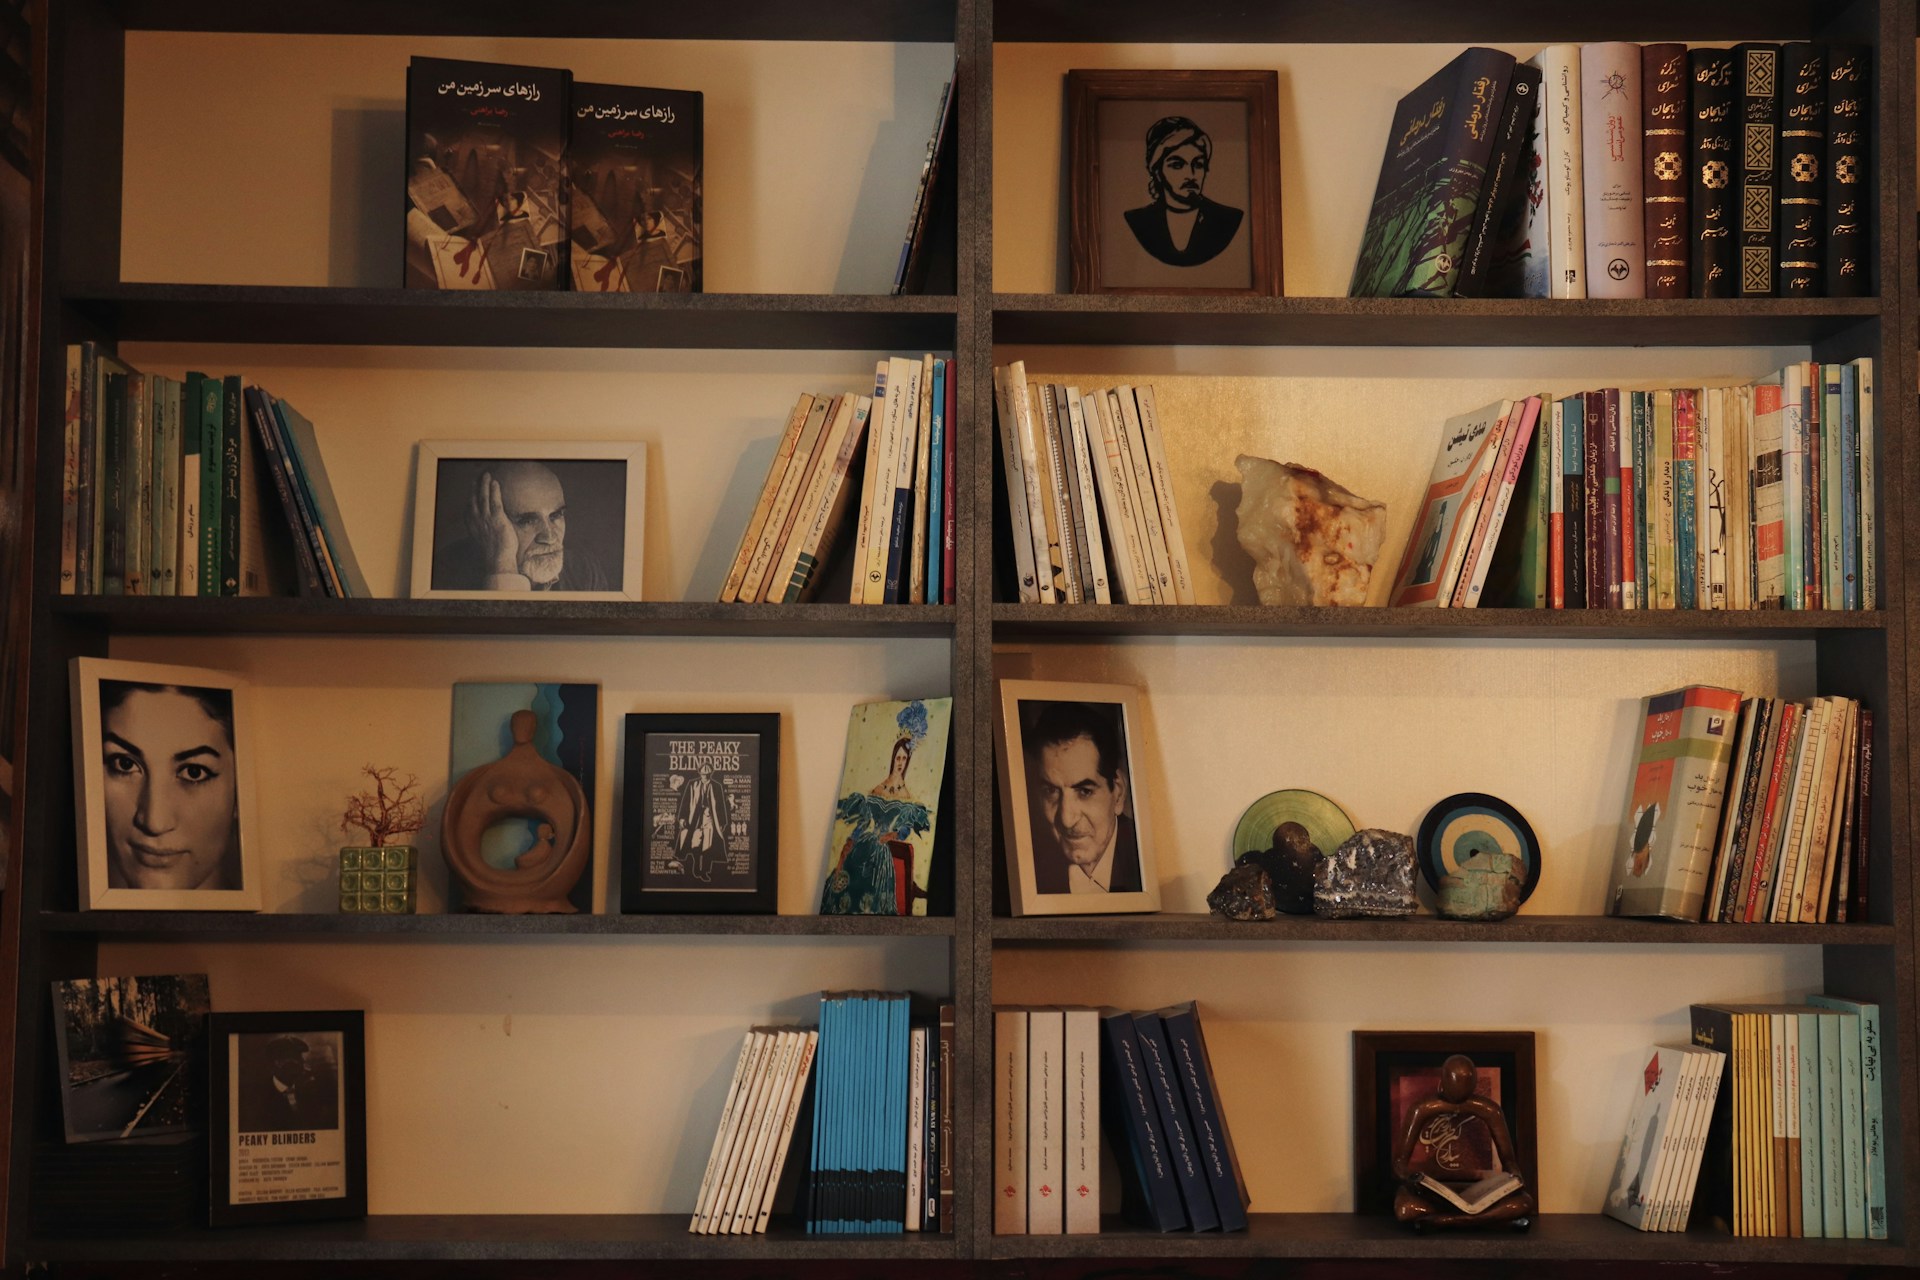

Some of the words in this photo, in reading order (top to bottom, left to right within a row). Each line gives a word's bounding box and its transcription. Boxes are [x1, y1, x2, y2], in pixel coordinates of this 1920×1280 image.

[1561, 65, 1570, 96] روانشناسی
[1696, 60, 1720, 84] شعرای
[438, 80, 455, 95] من
[457, 80, 502, 97] سرزمین
[503, 82, 541, 101] رازهای
[1472, 77, 1490, 104] رفتار
[1657, 75, 1682, 94] شعرای
[1795, 76, 1821, 95] شعرای
[576, 104, 594, 118] من
[594, 104, 637, 120] سرزمین
[639, 105, 676, 123] رازهای
[1560, 101, 1570, 134] کیمیاگری
[1651, 100, 1686, 120] آذربایجان
[1698, 102, 1732, 123] آذربایجان
[1789, 101, 1825, 121] آذربایجان
[1464, 104, 1483, 140] درمانی
[225, 438, 237, 463] مردان
[1514, 443, 1524, 460] دوران
[1608, 436, 1616, 453] ادبیات
[1588, 449, 1598, 463] زبان
[226, 464, 237, 477] زن
[1509, 460, 1521, 481] کودکی
[1587, 464, 1599, 487] شناسی
[1663, 461, 1671, 479] دیدار
[226, 478, 238, 499] ستیز
[1591, 488, 1599, 496] به
[1663, 486, 1672, 507] زندگی
[669, 741, 696, 755] THE
[699, 741, 741, 755] PEAKY
[669, 755, 740, 772] BLINDERS
[1687, 783, 1706, 794] خوب
[1866, 1019, 1876, 1036] سفر
[1865, 1036, 1873, 1044] به
[239, 1134, 269, 1146] PEAKY
[272, 1132, 317, 1145] BLINDERS
